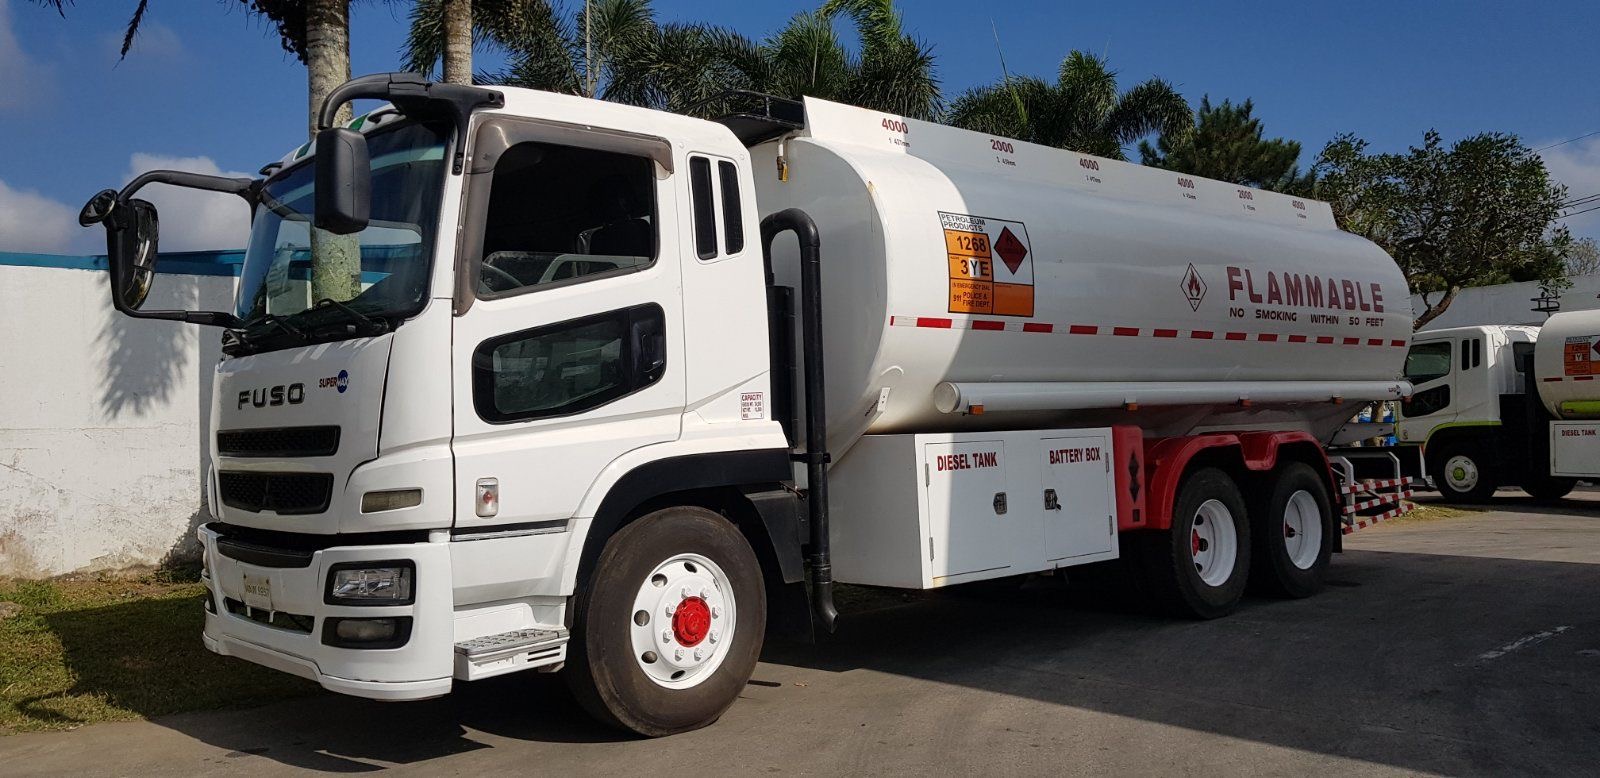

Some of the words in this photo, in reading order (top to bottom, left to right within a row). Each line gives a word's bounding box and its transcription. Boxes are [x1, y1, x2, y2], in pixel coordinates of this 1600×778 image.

[881, 117, 909, 135] 4000
[989, 138, 1014, 154] 2000
[1079, 157, 1100, 171] 4000
[1177, 176, 1195, 189] 4000
[1237, 189, 1253, 201] 2000
[941, 213, 986, 226] PETROLEUM
[943, 221, 984, 232] PRODUCTS
[957, 235, 987, 252] 1268
[960, 259, 990, 277] 3YE
[1226, 266, 1384, 313] FLAMMABLE
[1229, 307, 1245, 318] NO
[1255, 308, 1297, 322] SMOKING
[1310, 313, 1339, 325] WITHIN
[1349, 316, 1360, 326] 50
[1365, 317, 1384, 327] FEET
[237, 382, 306, 411] FUSO
[937, 453, 971, 471] DIESEL
[972, 451, 998, 469] TANK
[1049, 447, 1083, 465] BATTERY
[1085, 447, 1100, 462] BOX
